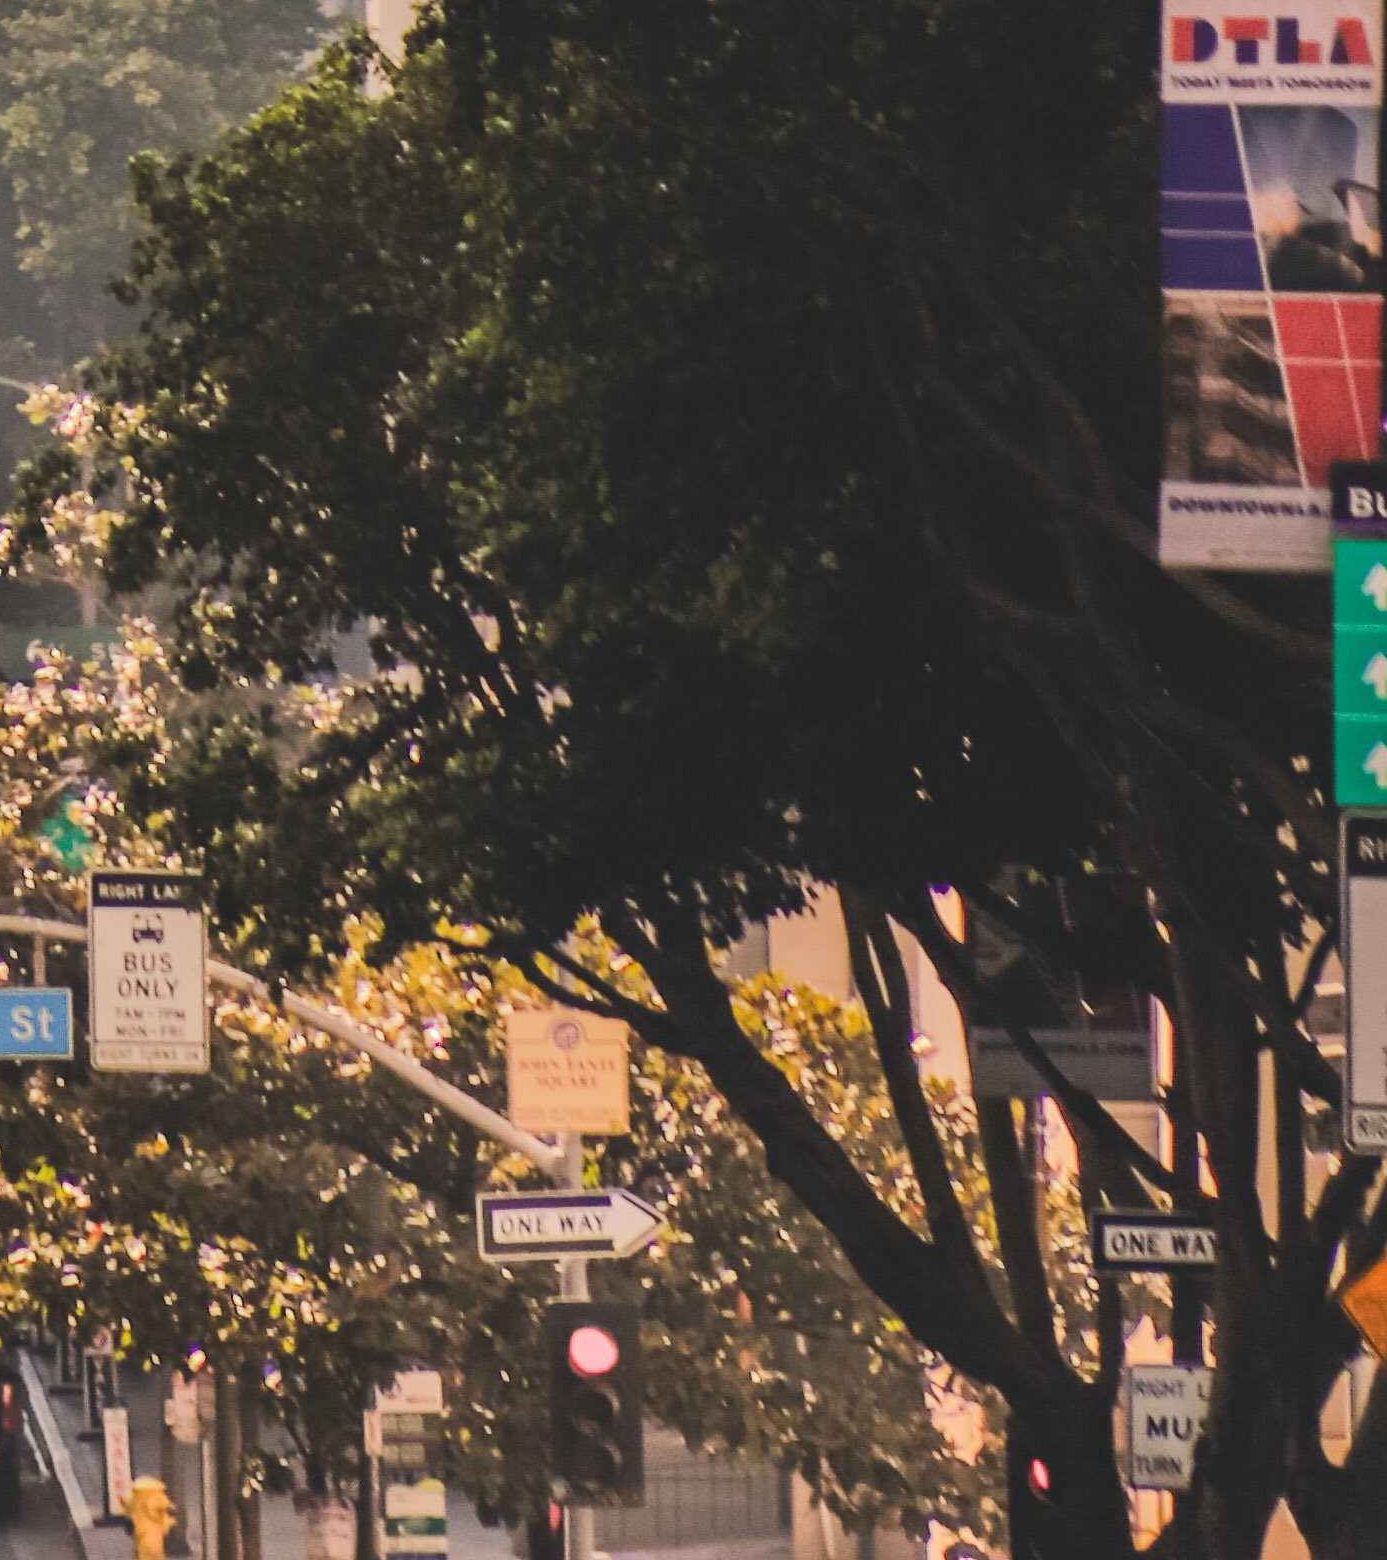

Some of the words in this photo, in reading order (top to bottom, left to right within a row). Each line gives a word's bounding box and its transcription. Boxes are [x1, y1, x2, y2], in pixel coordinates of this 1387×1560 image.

[1170, 15, 1373, 66] DTLA
[124, 952, 173, 972] BUS
[117, 977, 179, 999] ONLY
[10, 1005, 54, 1043] St
[499, 1214, 545, 1237] ONE
[558, 1213, 605, 1232] WAY
[1111, 1231, 1164, 1256] ONE
[1170, 1231, 1216, 1257] WAY
[1135, 1455, 1182, 1475] TURN
